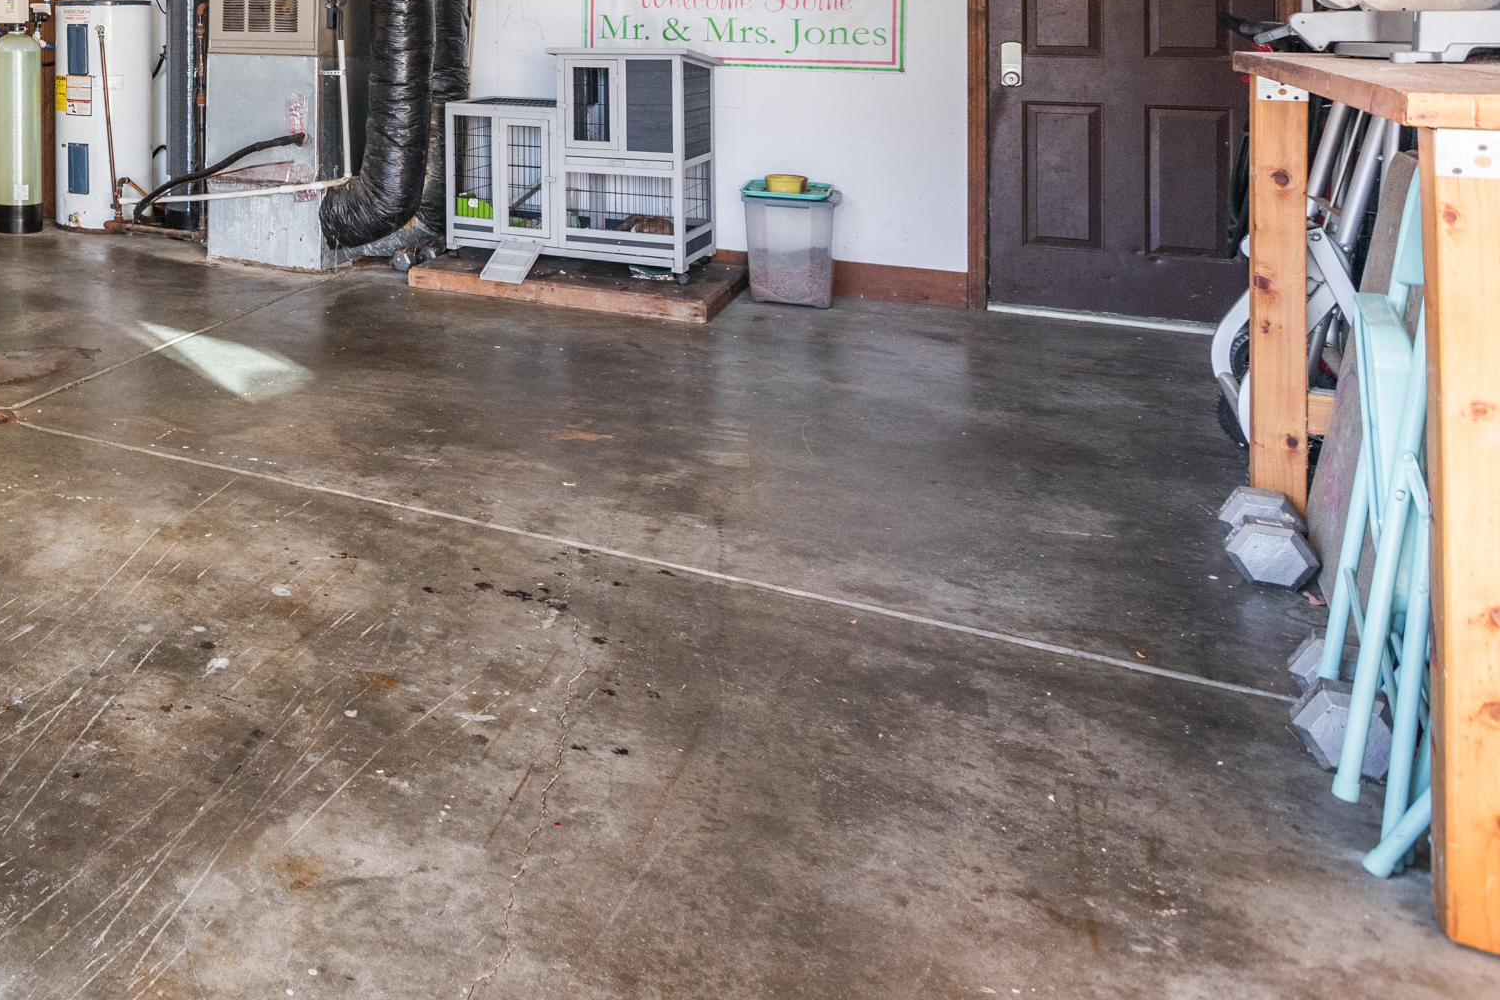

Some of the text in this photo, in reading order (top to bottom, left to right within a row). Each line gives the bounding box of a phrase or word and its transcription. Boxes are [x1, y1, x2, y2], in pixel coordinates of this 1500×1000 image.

[599, 14, 887, 53] Mr. & Mrs. Jones
